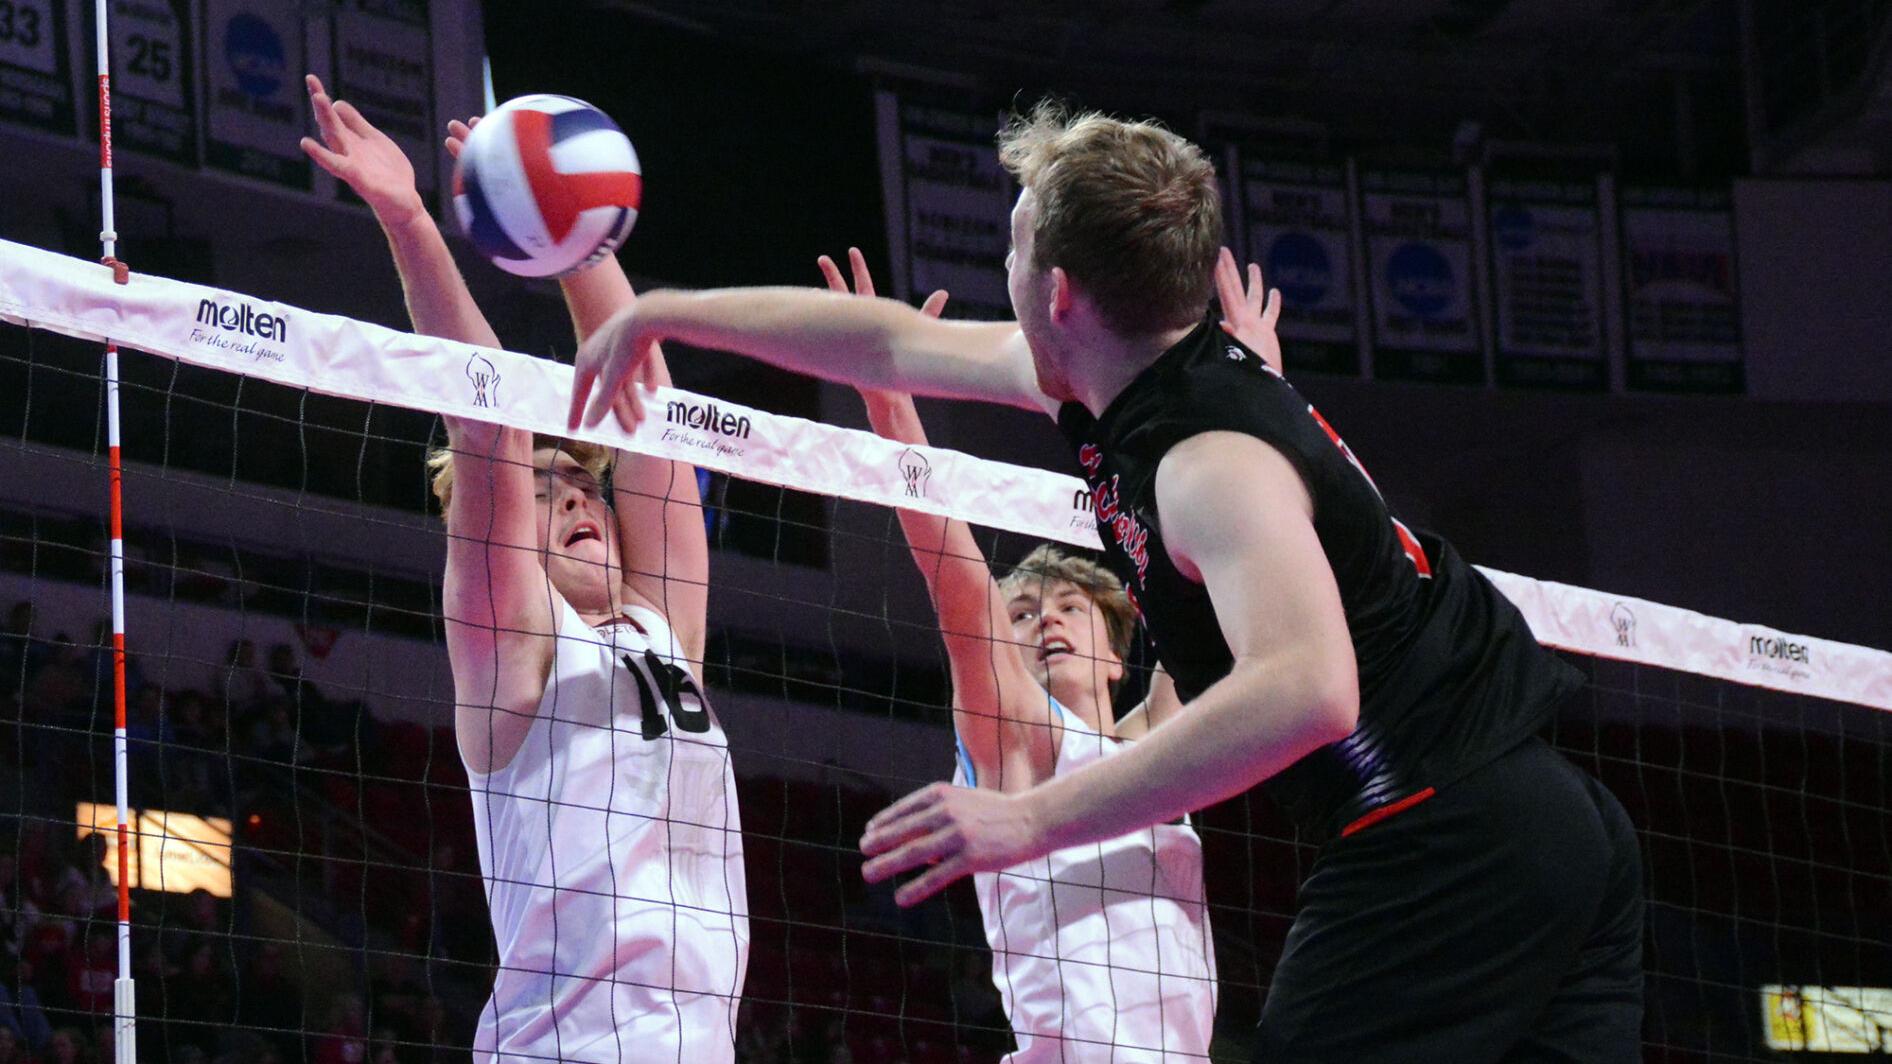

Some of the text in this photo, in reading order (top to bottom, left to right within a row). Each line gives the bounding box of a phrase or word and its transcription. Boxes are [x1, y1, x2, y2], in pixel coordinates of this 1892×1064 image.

[127, 33, 171, 82] 25
[196, 299, 286, 343] molten
[207, 334, 229, 349] the
[666, 400, 751, 439] molten
[620, 648, 712, 742] 16
